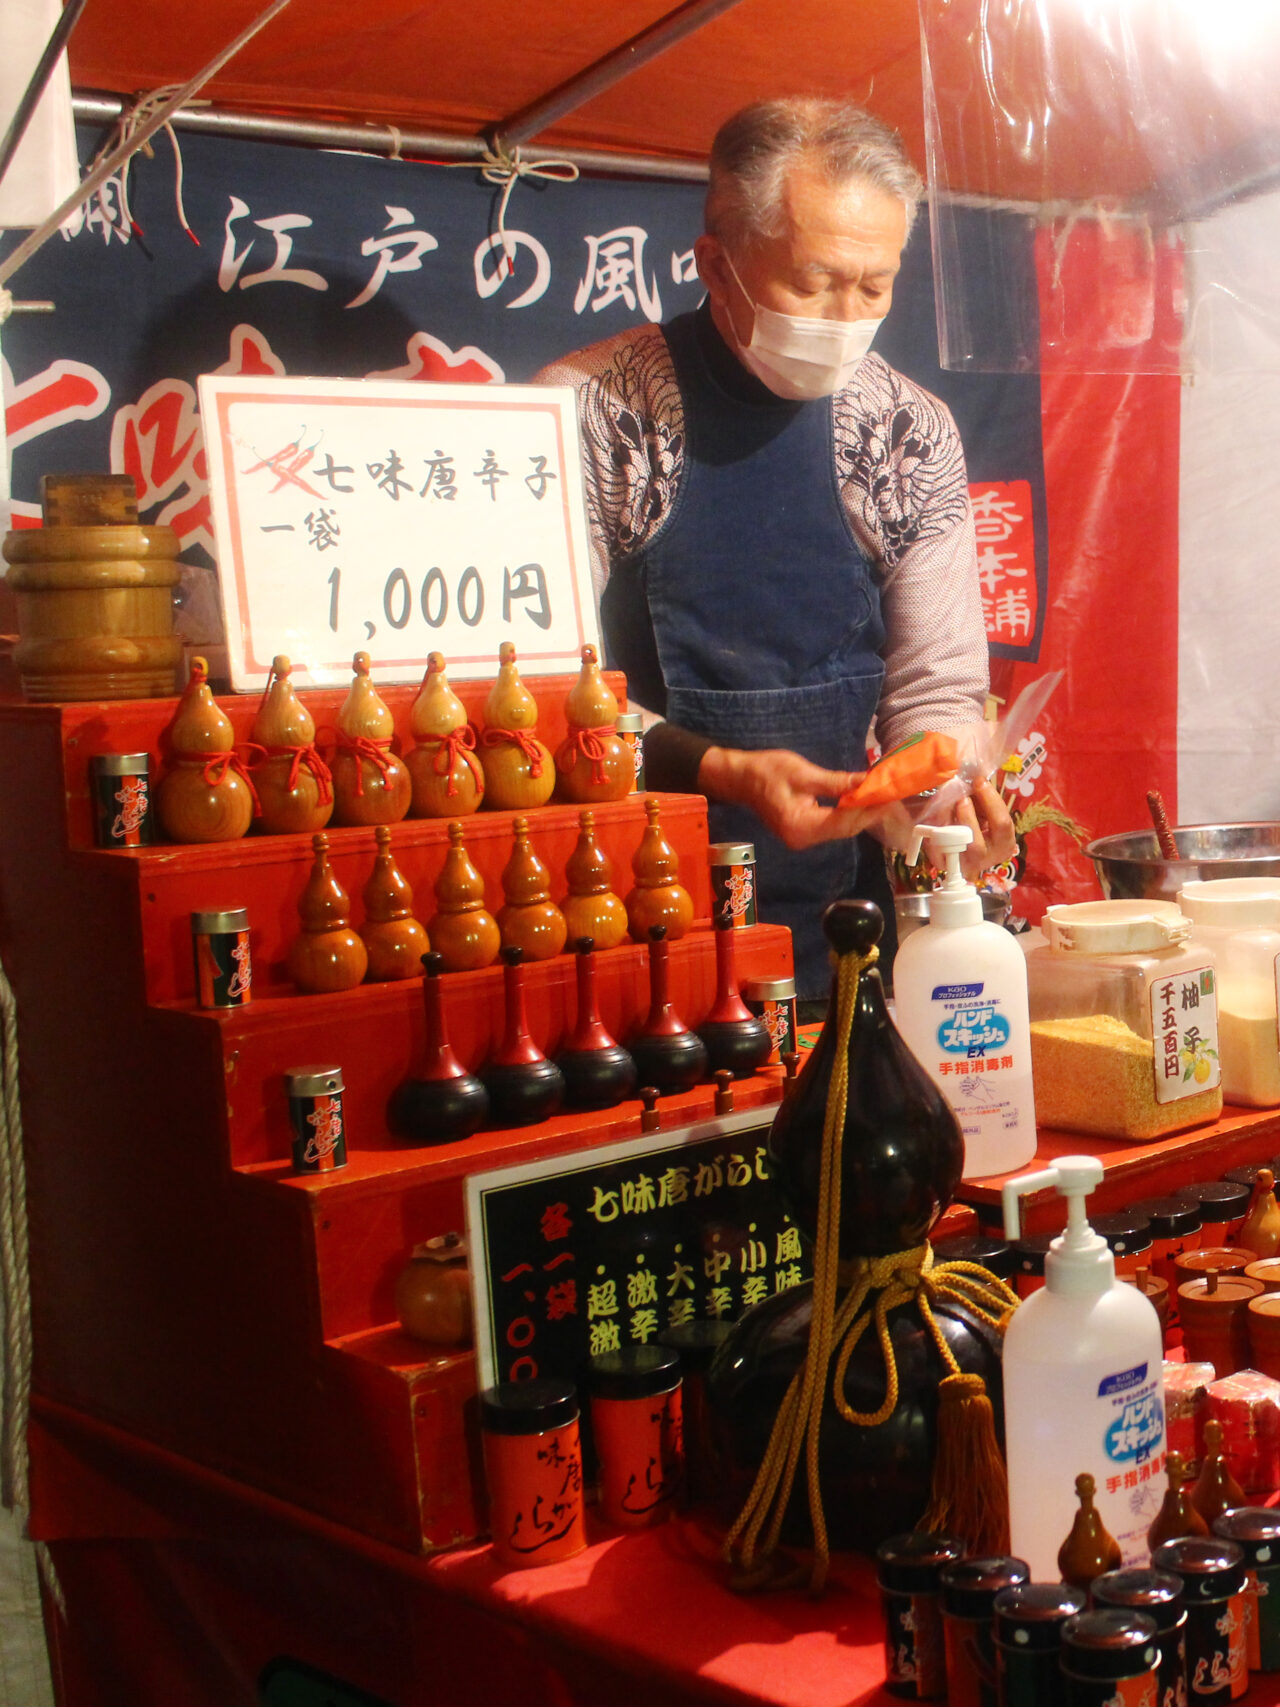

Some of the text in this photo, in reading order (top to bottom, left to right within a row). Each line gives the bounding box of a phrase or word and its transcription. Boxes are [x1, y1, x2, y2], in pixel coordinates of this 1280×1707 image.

[313, 449, 557, 501] 七味唐辛子
[259, 508, 341, 552] 一袋
[327, 563, 553, 640] 1,000円
[943, 1026, 1007, 1048] スキッシュ
[953, 1009, 995, 1029] ハンド
[1160, 981, 1180, 1079] 千五百円
[1181, 981, 1203, 1055] 柚子
[938, 1055, 1014, 1076] 手指消毒剤
[966, 1046, 987, 1059] EX
[586, 1146, 770, 1223] 七味唐がらし
